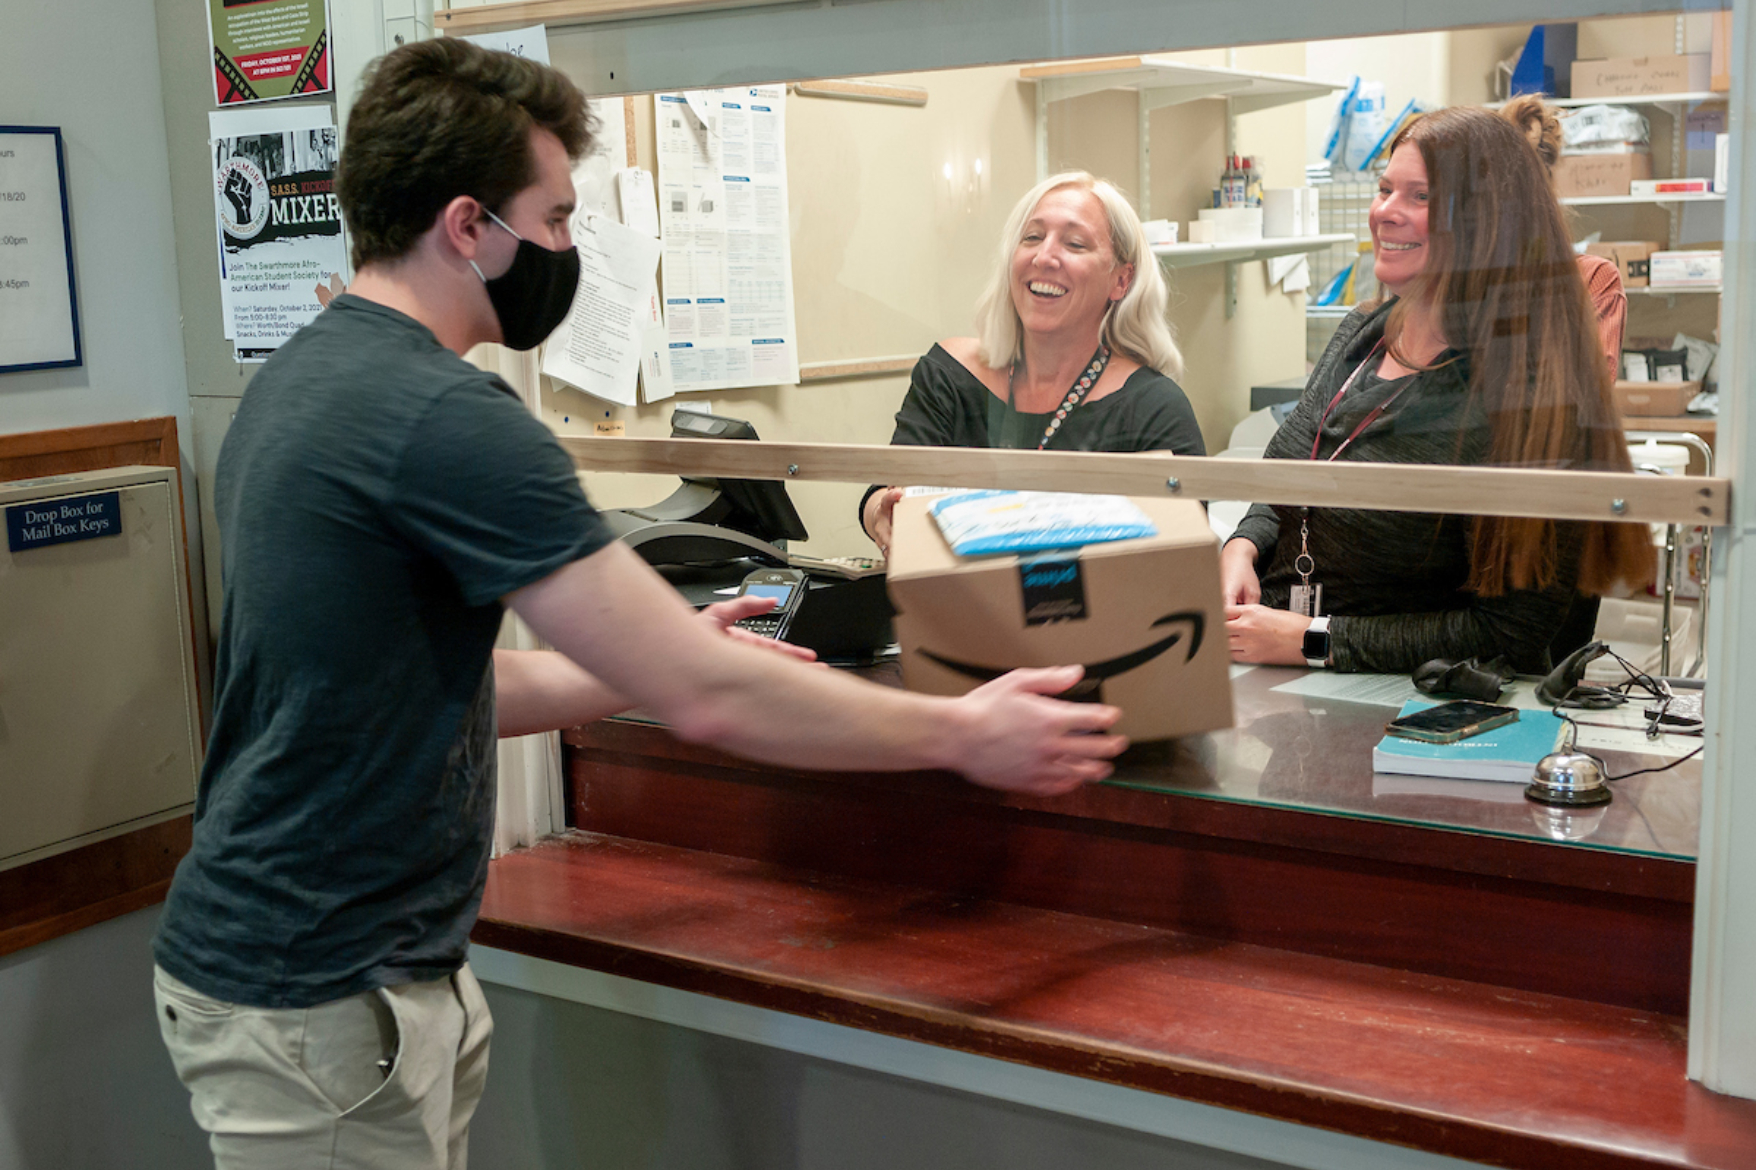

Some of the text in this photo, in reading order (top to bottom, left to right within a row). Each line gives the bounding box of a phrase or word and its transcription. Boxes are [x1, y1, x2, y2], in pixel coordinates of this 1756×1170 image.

[270, 193, 341, 225] MIXER
[229, 259, 321, 272] Join The Swarthmore Afro-
[230, 270, 331, 282] American Student Society for
[244, 282, 268, 291] Kickoff
[268, 281, 290, 291] Mixer!
[279, 303, 302, 312] October
[236, 330, 257, 338] Snacks,
[258, 330, 275, 338] Drinks
[25, 501, 104, 525] Drop Box for
[22, 518, 110, 542] Mail Box Keys
